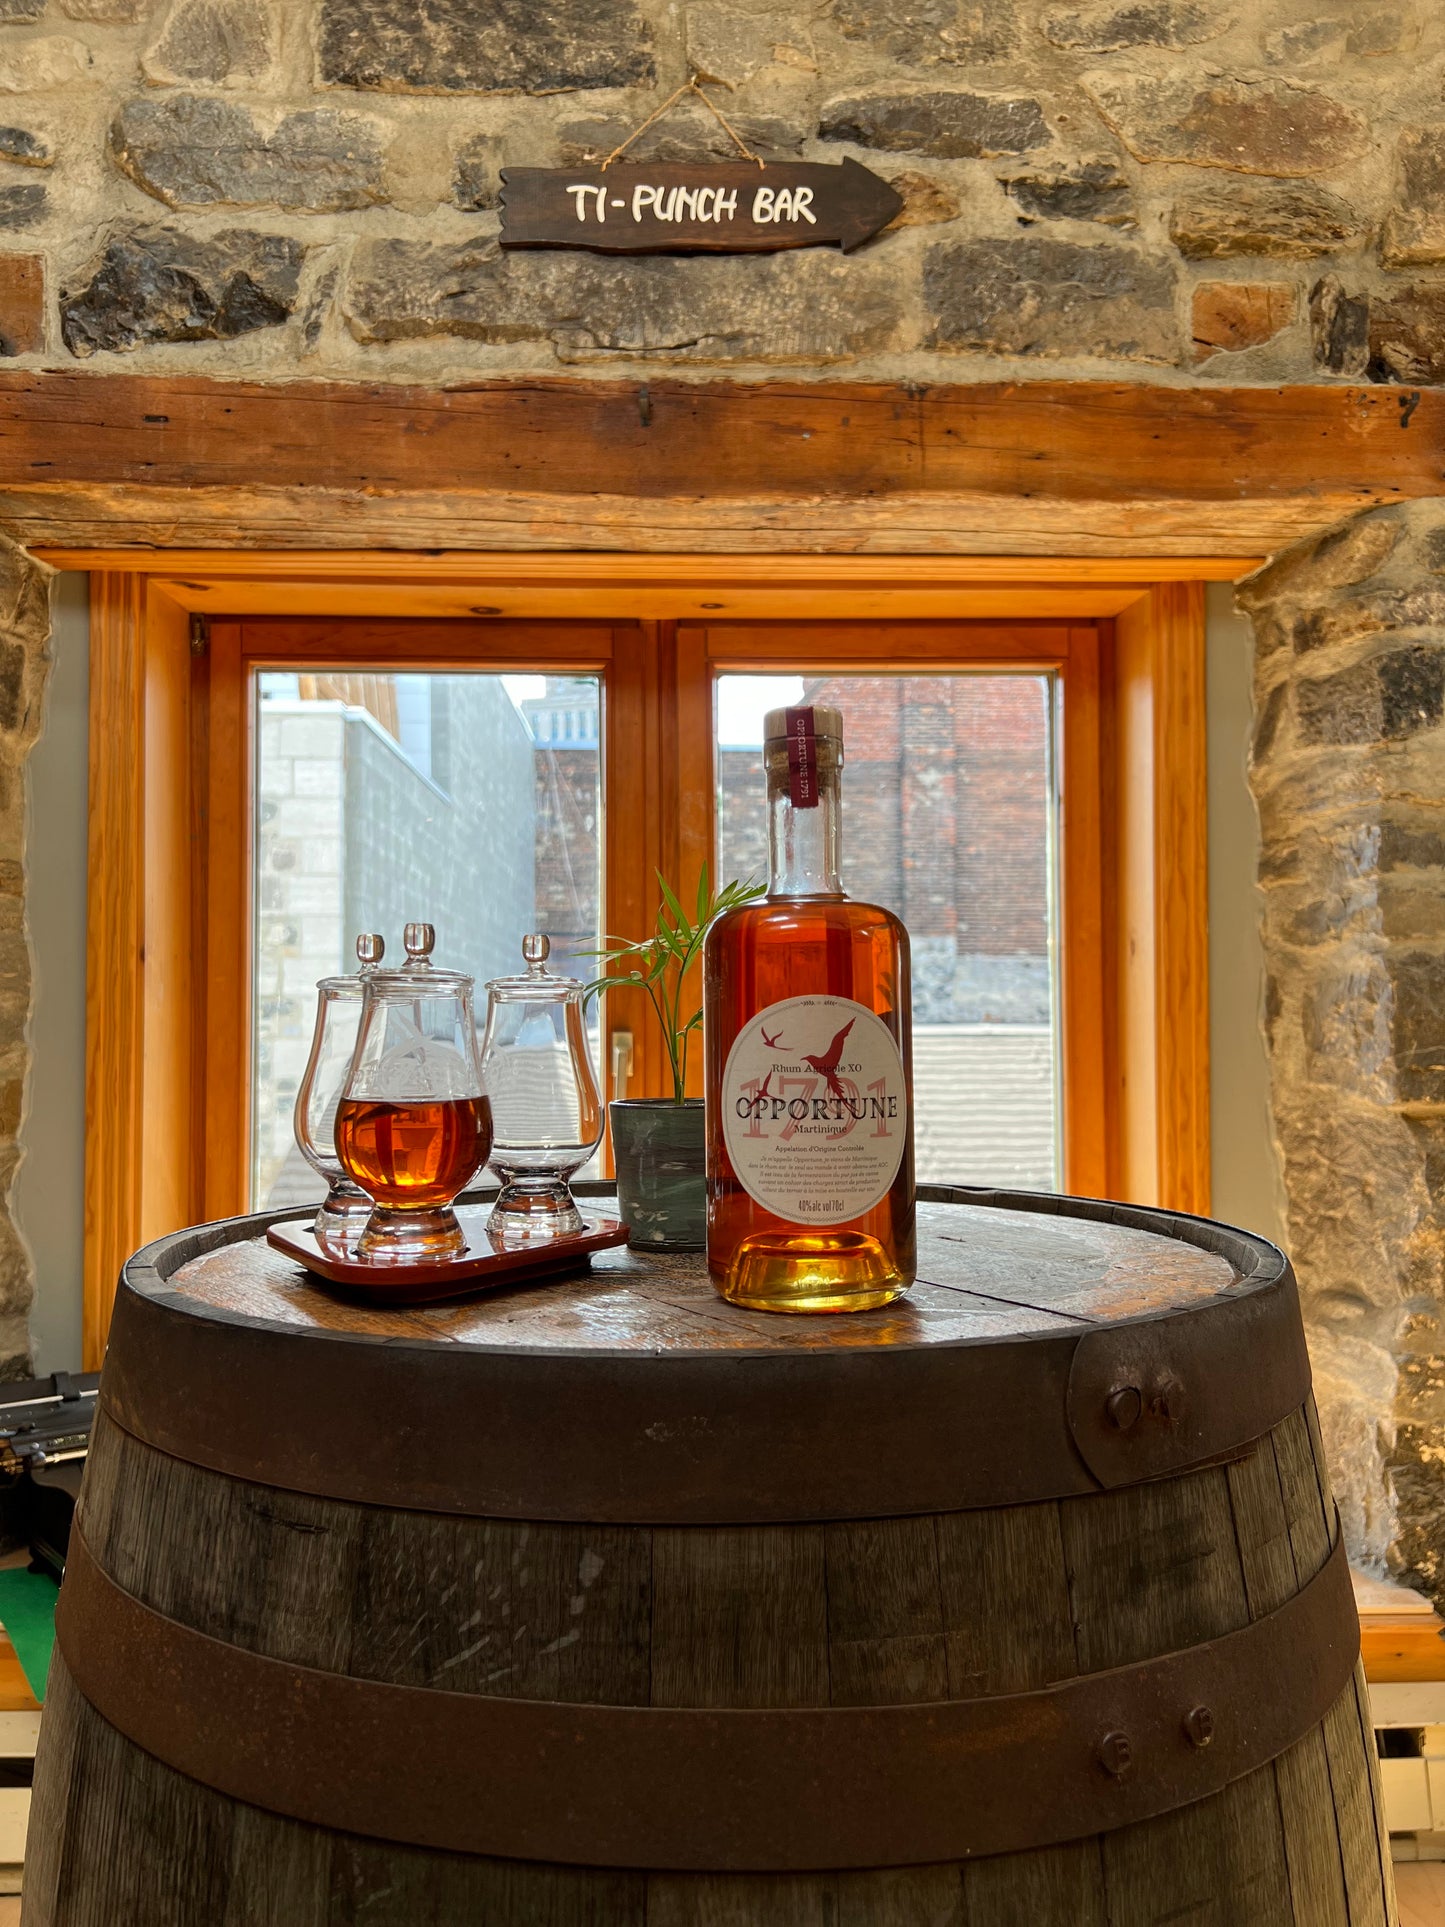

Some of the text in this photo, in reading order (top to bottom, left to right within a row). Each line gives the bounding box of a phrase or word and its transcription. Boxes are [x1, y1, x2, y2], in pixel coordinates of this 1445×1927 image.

[566, 185, 817, 225] TI-PUNCH BAR
[800, 780, 809, 799] 1791
[772, 1064, 802, 1073] Rhum
[848, 1064, 862, 1073] XO
[735, 1096, 898, 1121] OPPORTUNE
[794, 1124, 847, 1136] Martinique
